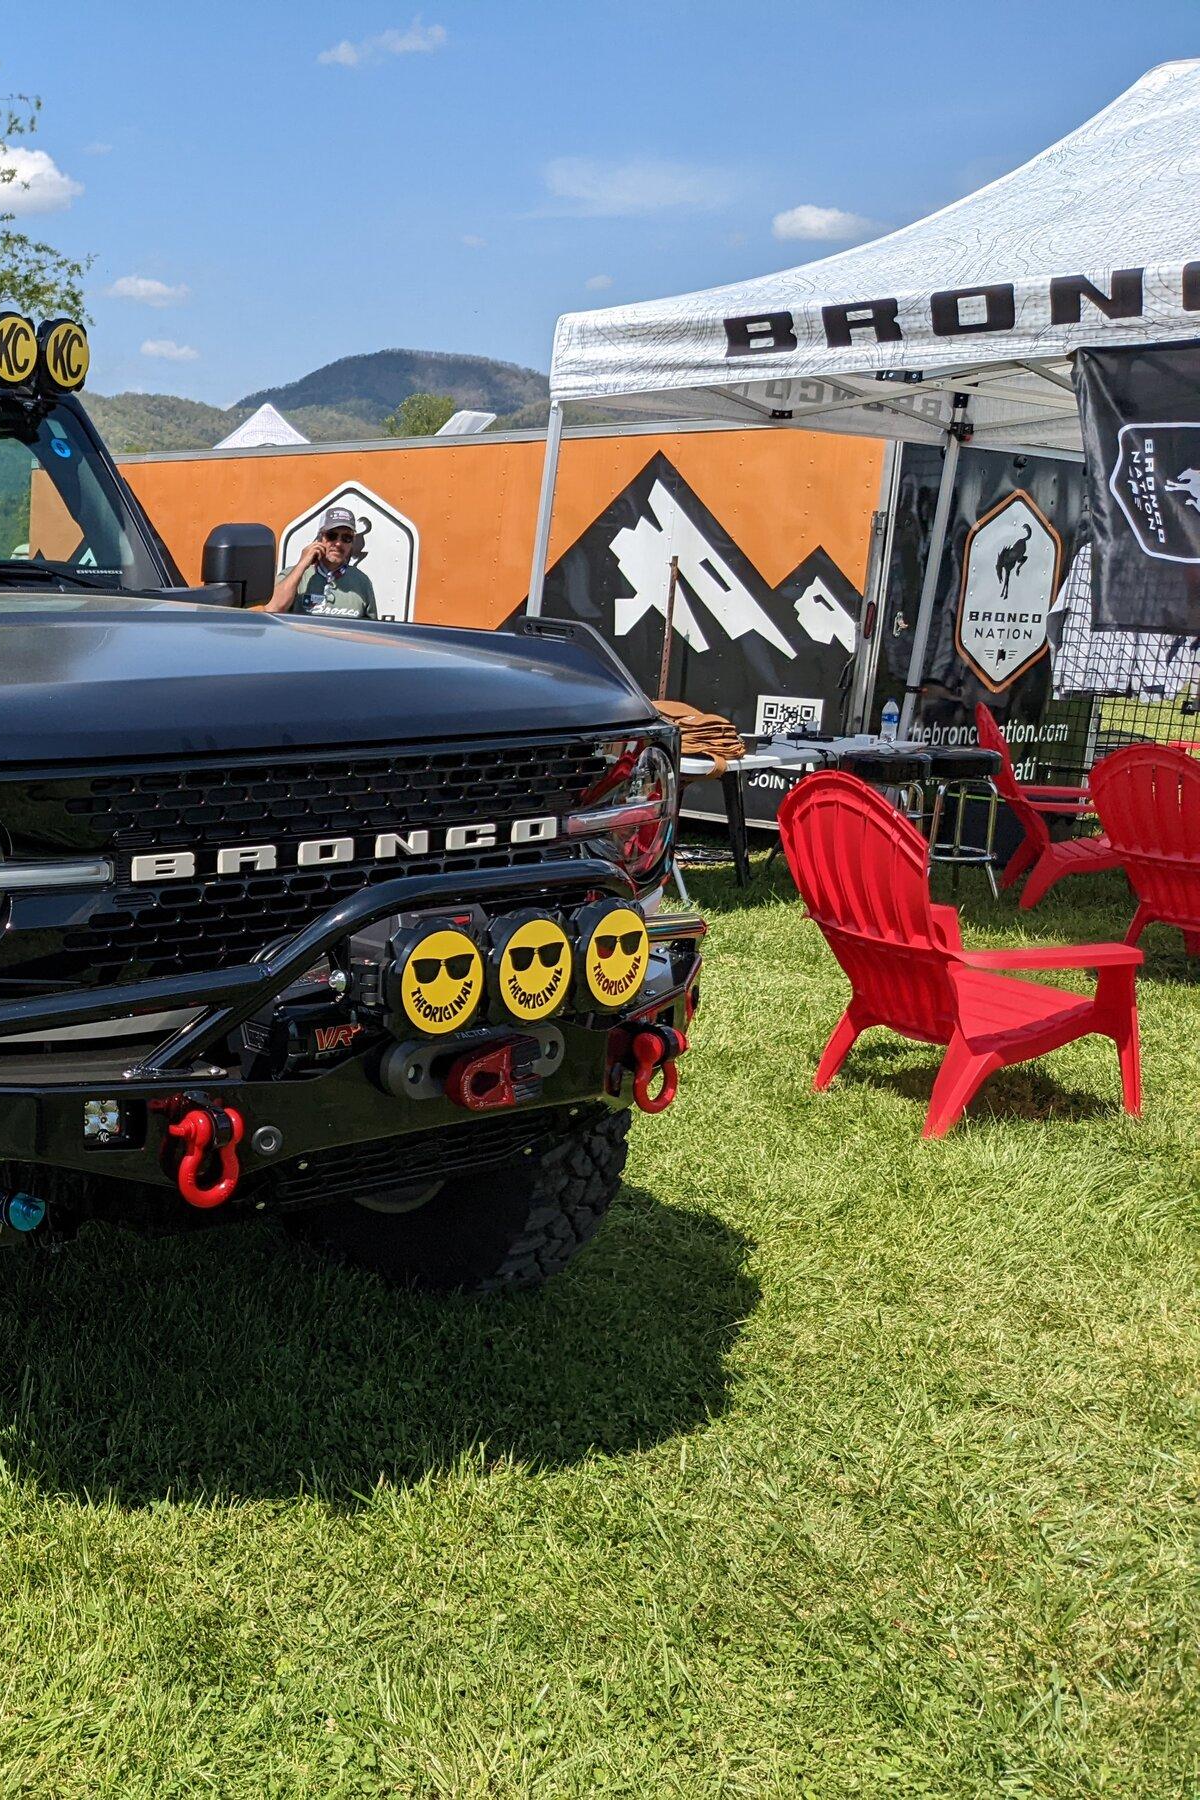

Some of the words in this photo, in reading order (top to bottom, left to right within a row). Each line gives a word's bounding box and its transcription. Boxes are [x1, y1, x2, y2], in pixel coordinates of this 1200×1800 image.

[724, 261, 1200, 357] BRON
[0, 322, 30, 376] KC
[52, 328, 83, 381] KC
[1131, 451, 1156, 531] NATION
[1144, 439, 1166, 544] BRONCO
[969, 611, 1042, 624] BRONCO
[974, 628, 1033, 640] NATION
[748, 773, 785, 790] JOIN
[131, 816, 557, 882] BRONCO
